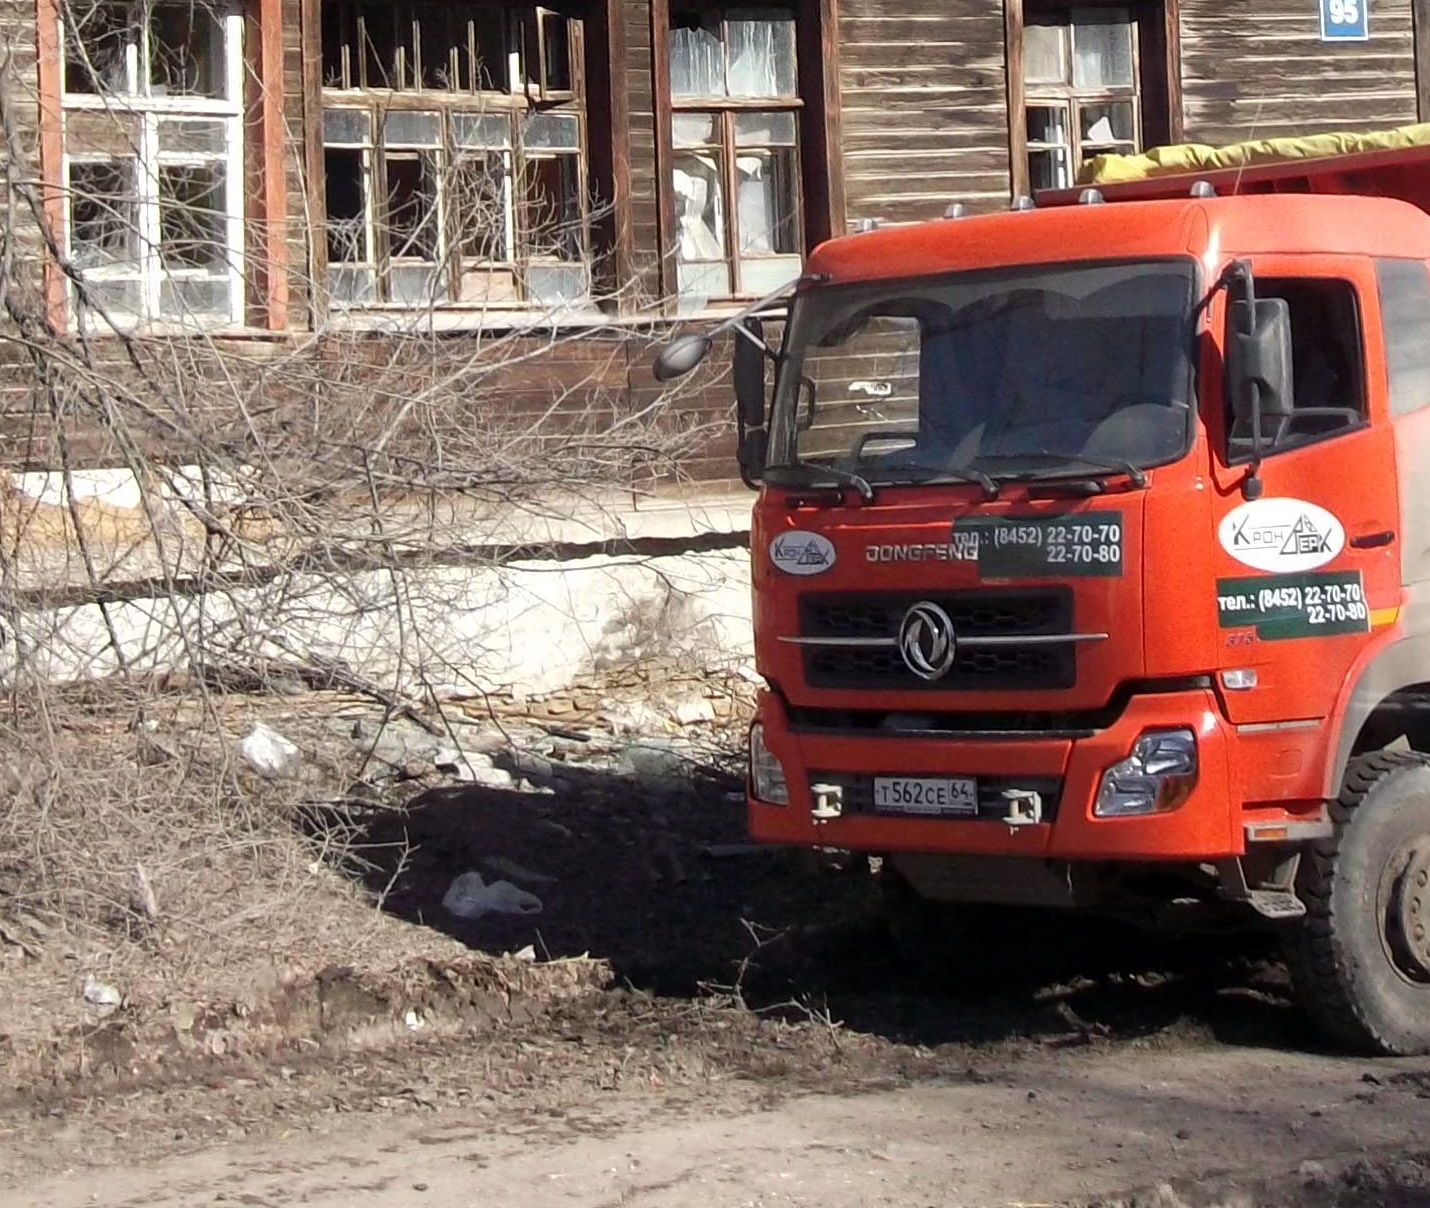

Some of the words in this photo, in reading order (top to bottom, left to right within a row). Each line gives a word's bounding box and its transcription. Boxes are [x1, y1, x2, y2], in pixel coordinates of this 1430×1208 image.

[994, 526, 1042, 549] (8452)
[1046, 525, 1120, 543] 22-70-70
[1046, 545, 1120, 563] 22-70-80
[1218, 594, 1255, 611] тел.:
[1258, 586, 1302, 613] (8452)
[1304, 583, 1360, 606] 22-70-70
[1307, 602, 1366, 624] 22-70-80
[951, 782, 969, 799] 64
